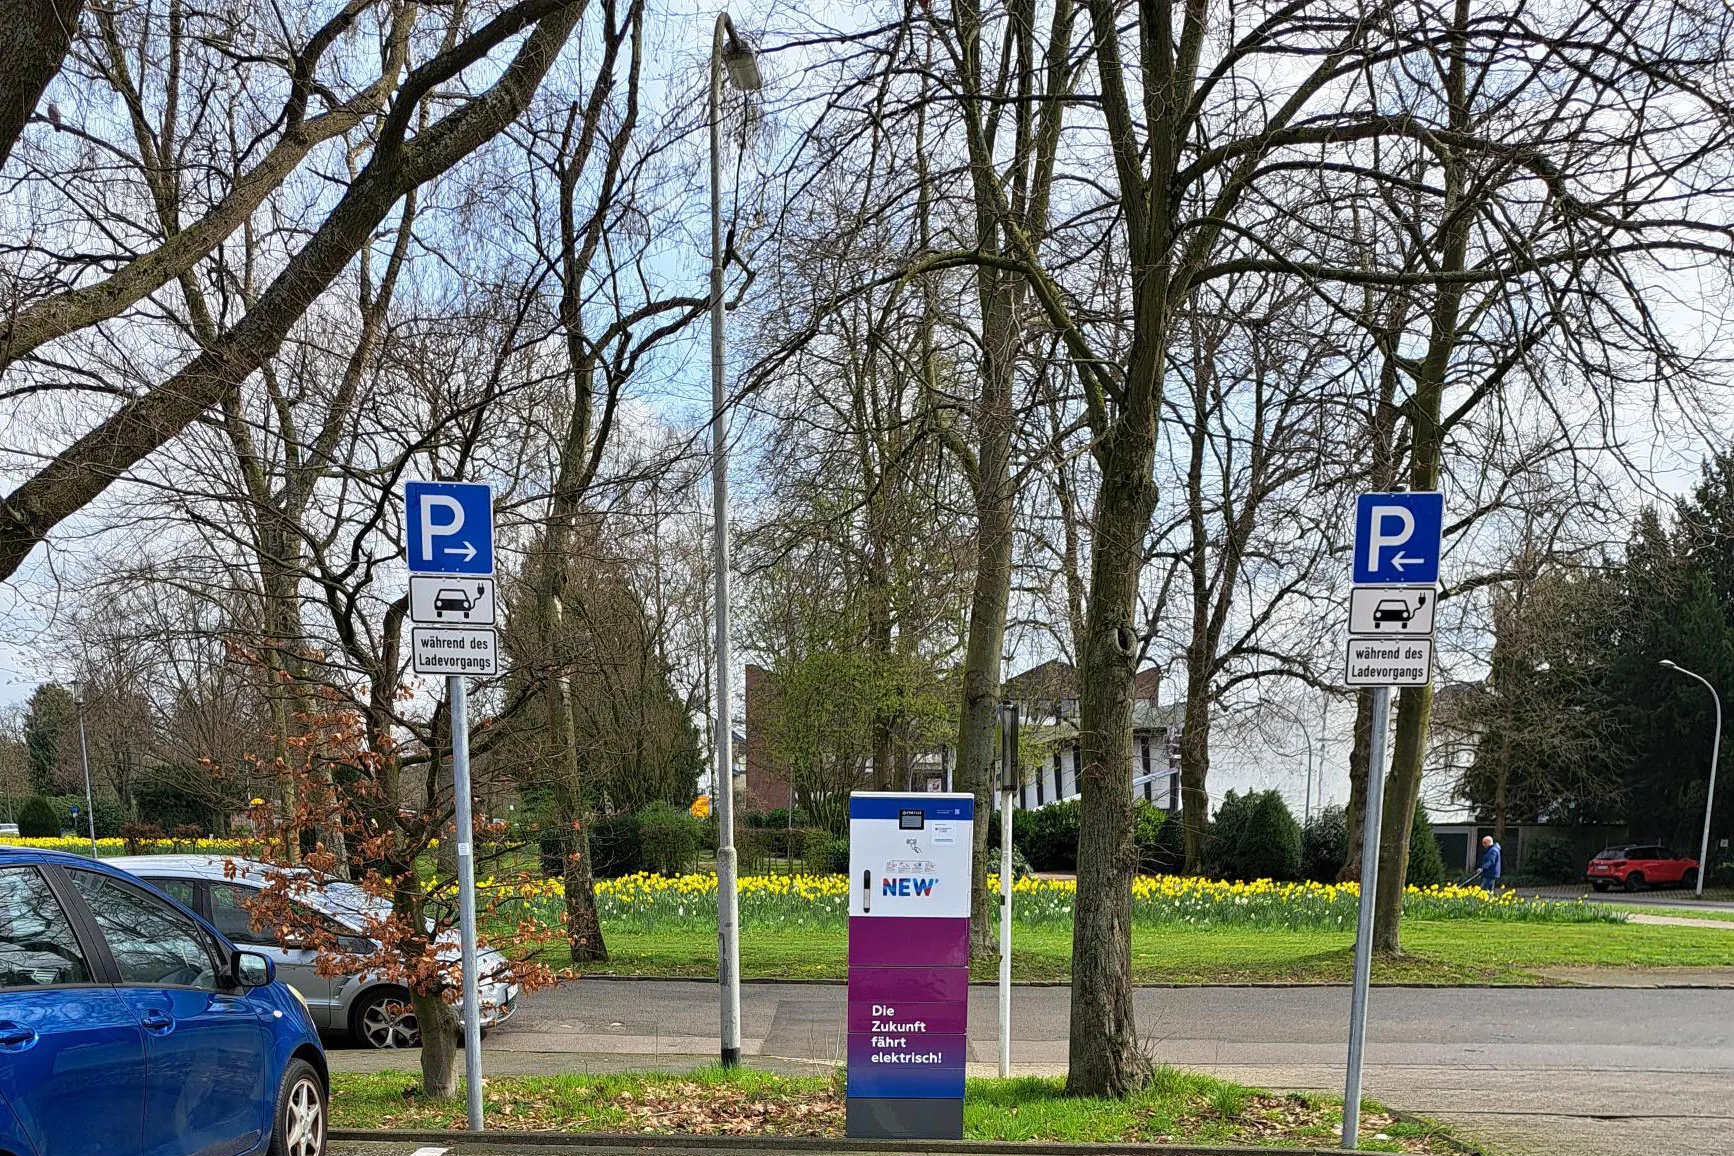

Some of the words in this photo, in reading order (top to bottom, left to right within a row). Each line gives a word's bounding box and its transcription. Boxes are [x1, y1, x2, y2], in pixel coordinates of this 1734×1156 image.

[420, 494, 465, 561] P
[1367, 505, 1415, 572] P
[420, 636, 465, 649] während
[470, 636, 488, 650] des
[1355, 646, 1400, 660] während
[1405, 646, 1423, 660] des
[418, 653, 491, 670] Ladevorgangs
[1351, 665, 1424, 681] Ladevorgangs
[871, 1004, 895, 1017] Die
[871, 1020, 926, 1032] Zukunft
[870, 1036, 907, 1048] fährt
[871, 1051, 942, 1064] elektrisch!
